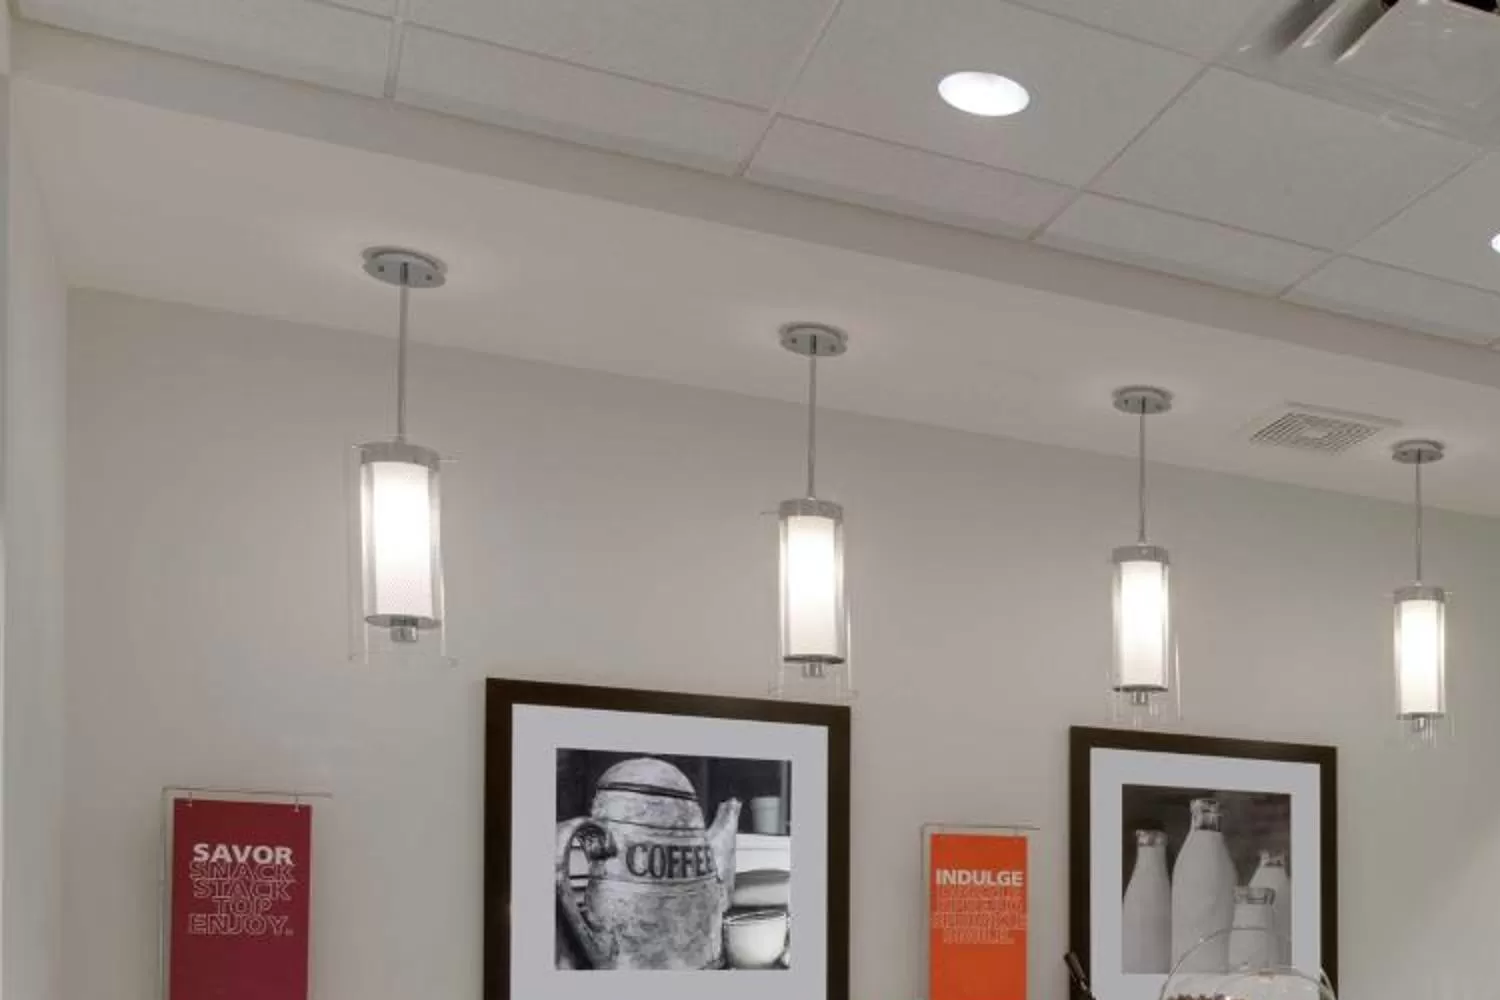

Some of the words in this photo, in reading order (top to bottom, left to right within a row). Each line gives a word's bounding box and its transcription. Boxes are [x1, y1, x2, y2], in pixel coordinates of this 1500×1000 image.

[192, 843, 294, 865] SAVOR
[189, 861, 297, 882] SNACK
[935, 868, 1025, 887] INDULGE
[193, 878, 293, 901] STACK
[212, 896, 273, 916] TOP
[188, 913, 294, 937] ENJOY.
